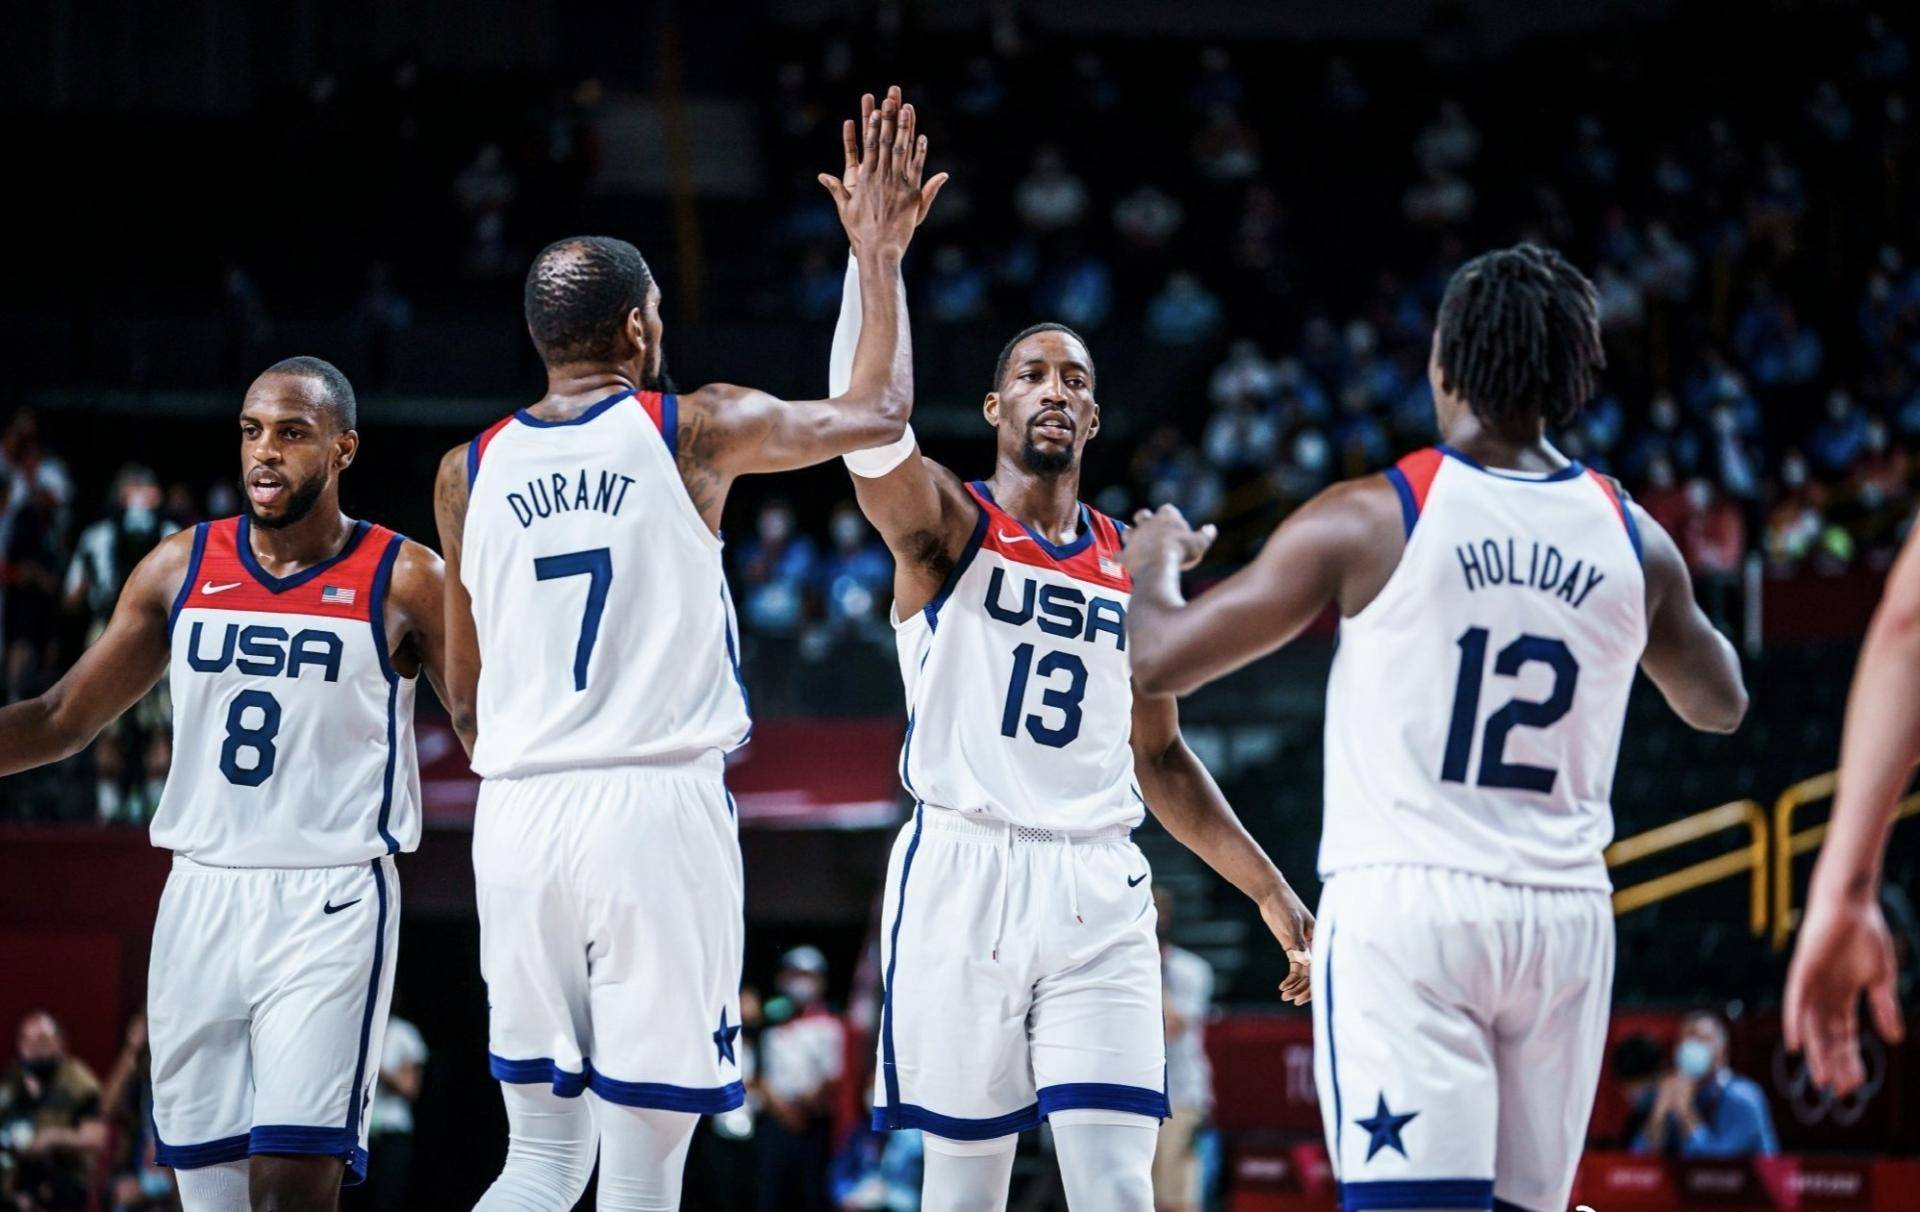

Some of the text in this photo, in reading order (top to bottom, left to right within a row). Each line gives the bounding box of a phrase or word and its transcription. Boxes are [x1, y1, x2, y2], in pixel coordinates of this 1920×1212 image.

[506, 470, 636, 529] DURANT
[534, 547, 613, 692] 7
[984, 566, 1127, 652] USA
[1457, 539, 1604, 608] HOLIDAY
[187, 621, 344, 683] USA
[1000, 642, 1089, 749] 13
[219, 688, 282, 788] 8
[1441, 626, 1580, 796] 12
